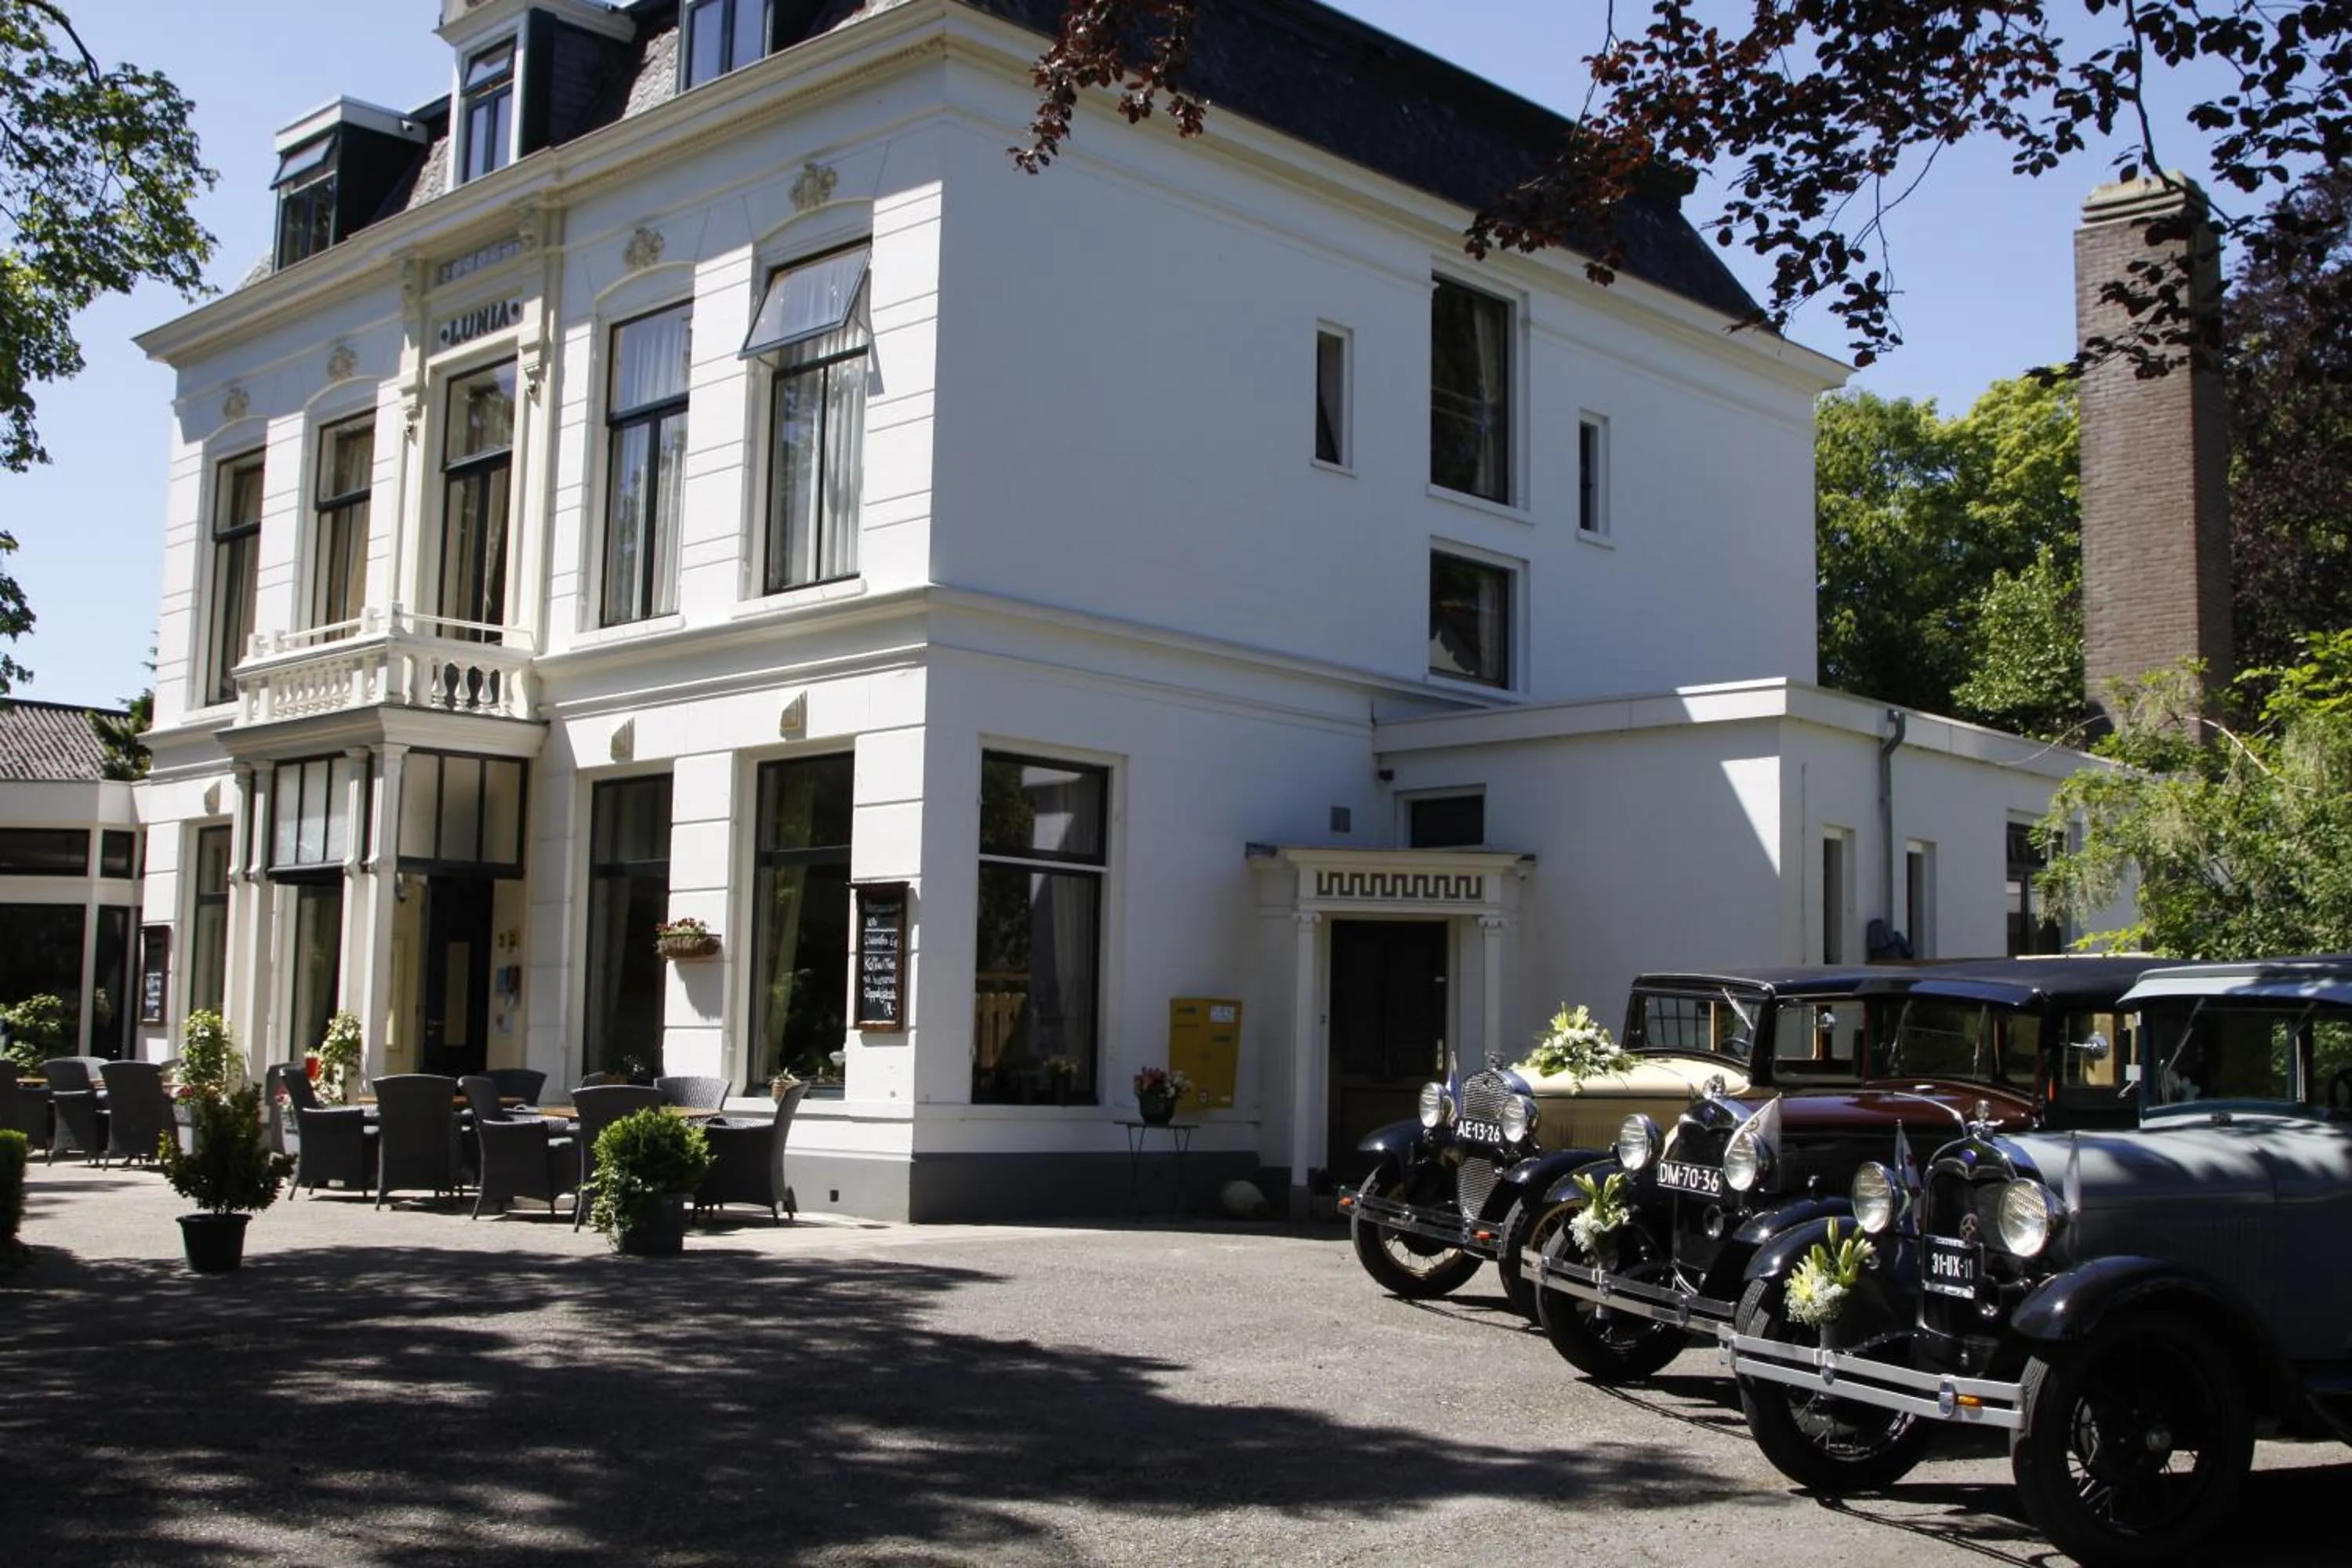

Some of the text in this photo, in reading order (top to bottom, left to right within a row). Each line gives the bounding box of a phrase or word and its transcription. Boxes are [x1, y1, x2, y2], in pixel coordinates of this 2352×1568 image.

[449, 301, 510, 346] LUNIA
[1456, 1120, 1501, 1143] AE-13-26
[1659, 1163, 1720, 1192] DM-70-36
[1931, 1252, 1974, 1280] 31-UX-11
